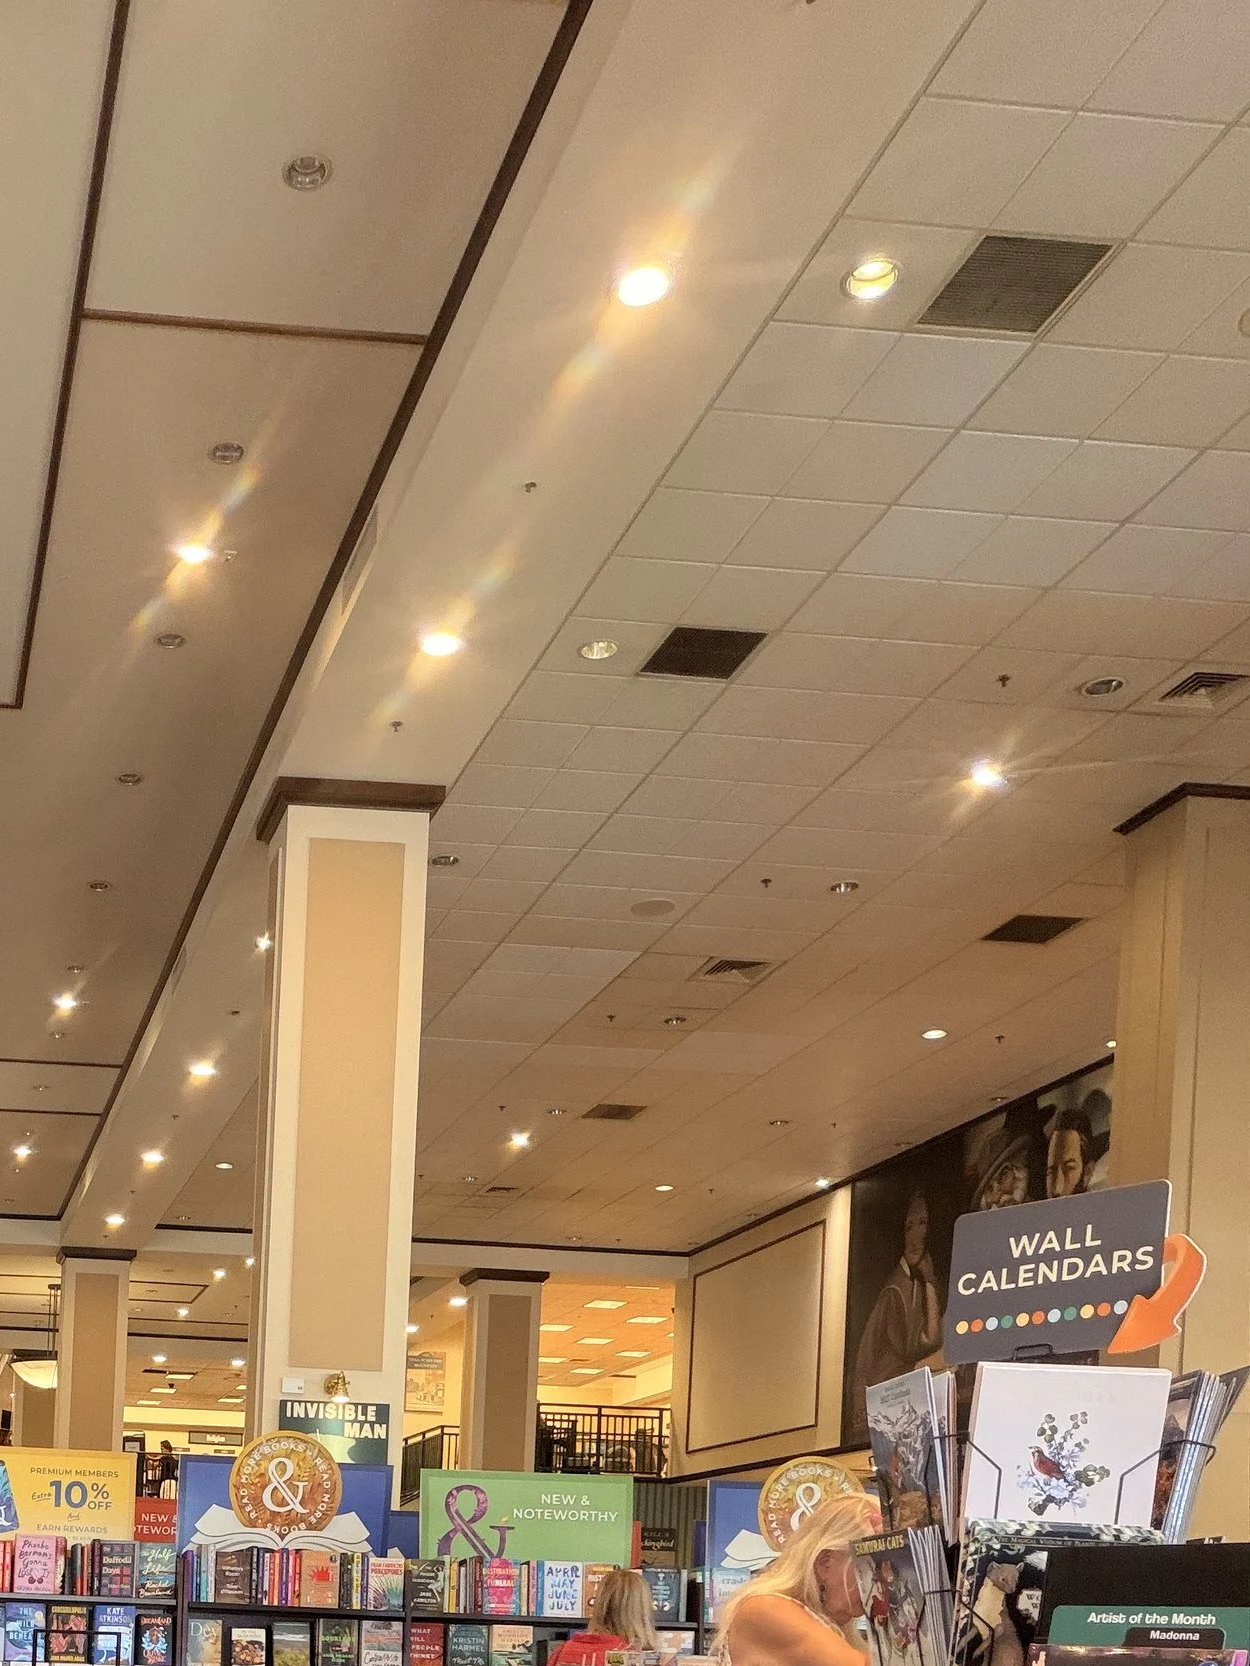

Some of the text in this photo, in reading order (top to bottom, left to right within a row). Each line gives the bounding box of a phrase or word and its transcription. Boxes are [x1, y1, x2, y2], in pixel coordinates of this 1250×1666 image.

[1008, 1223, 1102, 1259] WALL
[957, 1245, 1155, 1296] CALENDARS
[285, 1401, 378, 1421] INVISIBLE
[344, 1422, 388, 1440] MAN
[30, 1466, 120, 1479] PREMIUM MEMBERS
[239, 1439, 332, 1535] READ MORE BOOKS READ MORE BOOKS
[31, 1479, 111, 1510] Extra 10%
[541, 1493, 591, 1506] NEW &
[87, 1500, 113, 1511] OFF
[766, 1463, 833, 1545] READ MORE BOOKS
[141, 1513, 170, 1523] NEW
[512, 1508, 619, 1523] NOTEWORTHY
[36, 1523, 109, 1535] EARN REWARDS
[855, 1534, 905, 1556] SAMURAI CATS
[102, 1556, 132, 1564] Daffodil
[149, 1548, 177, 1561] Half
[22, 1558, 48, 1569] Gonna
[142, 1562, 174, 1575] Life
[102, 1565, 121, 1575] Days
[145, 1580, 174, 1589] Rachel
[550, 1579, 575, 1589] MAY
[548, 1589, 578, 1600] JUNE
[19, 1607, 32, 1615] THE
[549, 1600, 576, 1611] JULY
[106, 1607, 125, 1616] KATE
[17, 1619, 35, 1628] WILD
[99, 1615, 131, 1624] ATKINSON
[1087, 1612, 1217, 1625] Artist of the Month
[1149, 1630, 1200, 1641] Madonna
[451, 1644, 485, 1652] HARMEL
